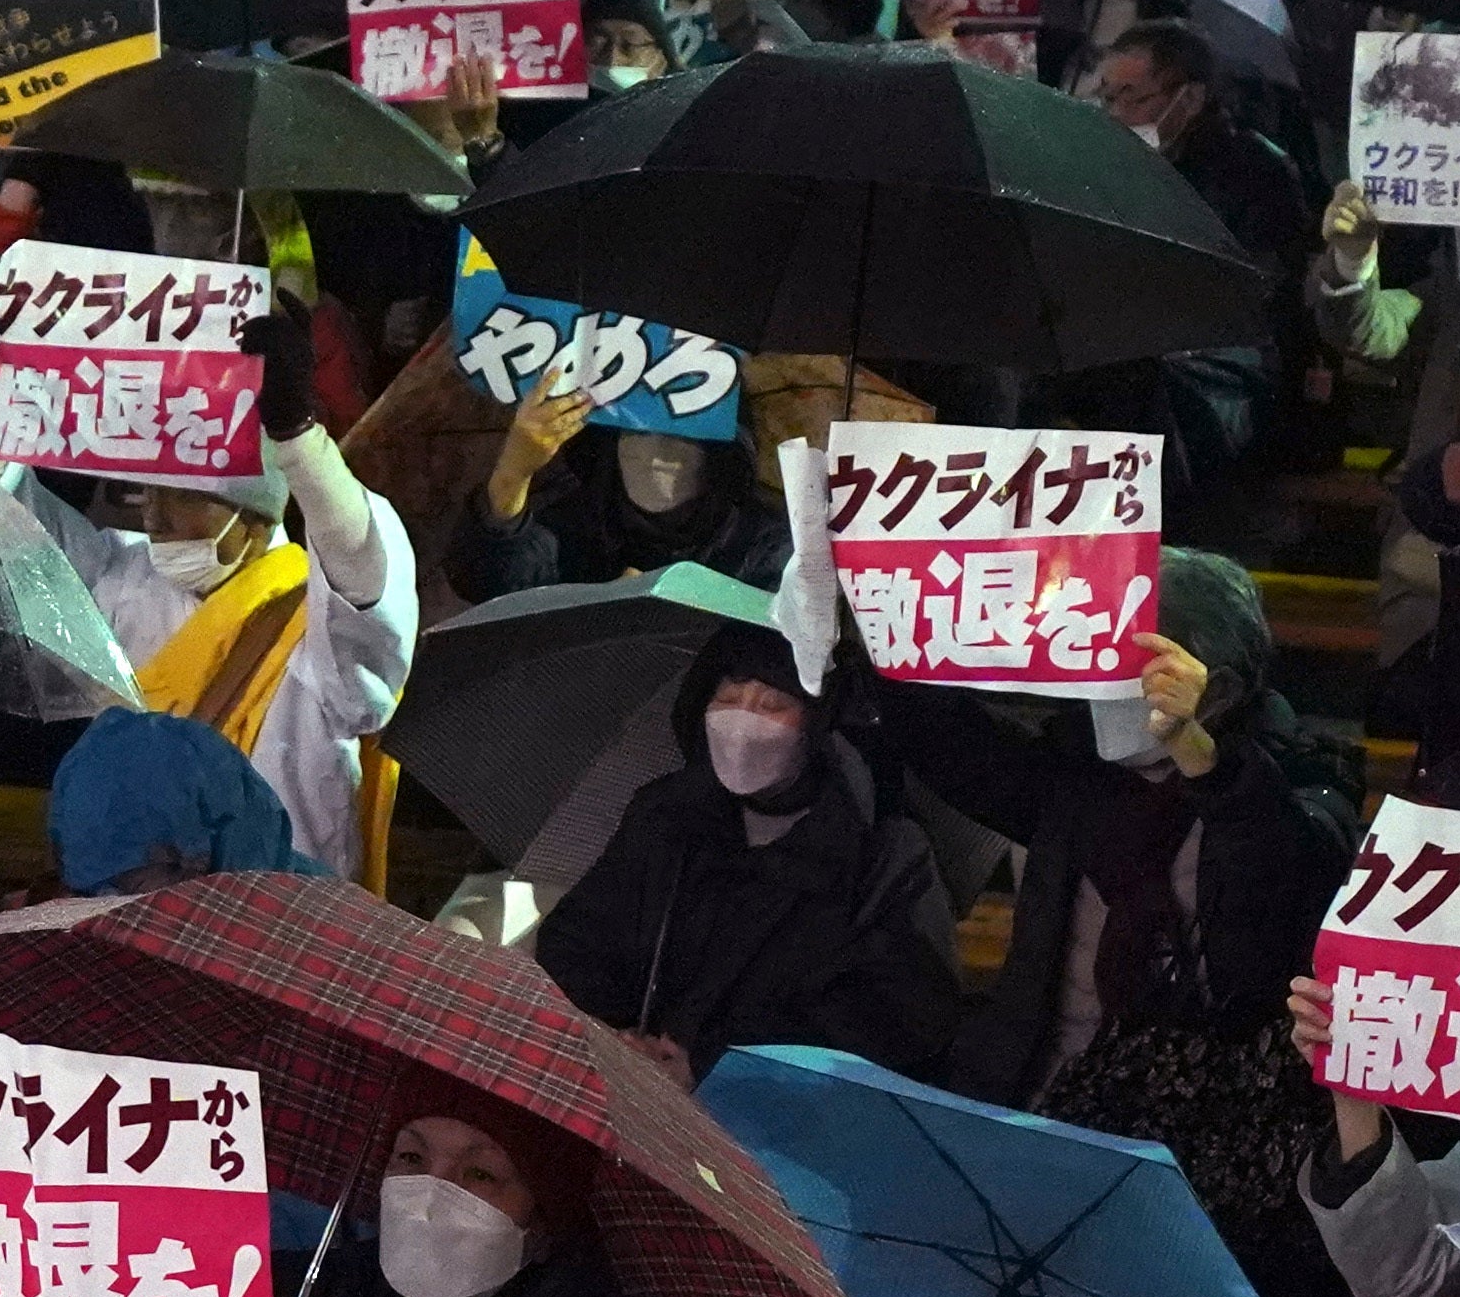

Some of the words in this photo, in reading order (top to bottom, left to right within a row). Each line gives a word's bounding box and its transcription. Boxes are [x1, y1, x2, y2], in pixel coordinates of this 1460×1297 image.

[18, 69, 70, 99] the
[360, 11, 579, 99] 撤退を!
[1363, 177, 1460, 208] 平和を!
[460, 309, 741, 416] やめろ
[828, 443, 1152, 532] ウクライナから
[837, 549, 1152, 672] 撤退を!
